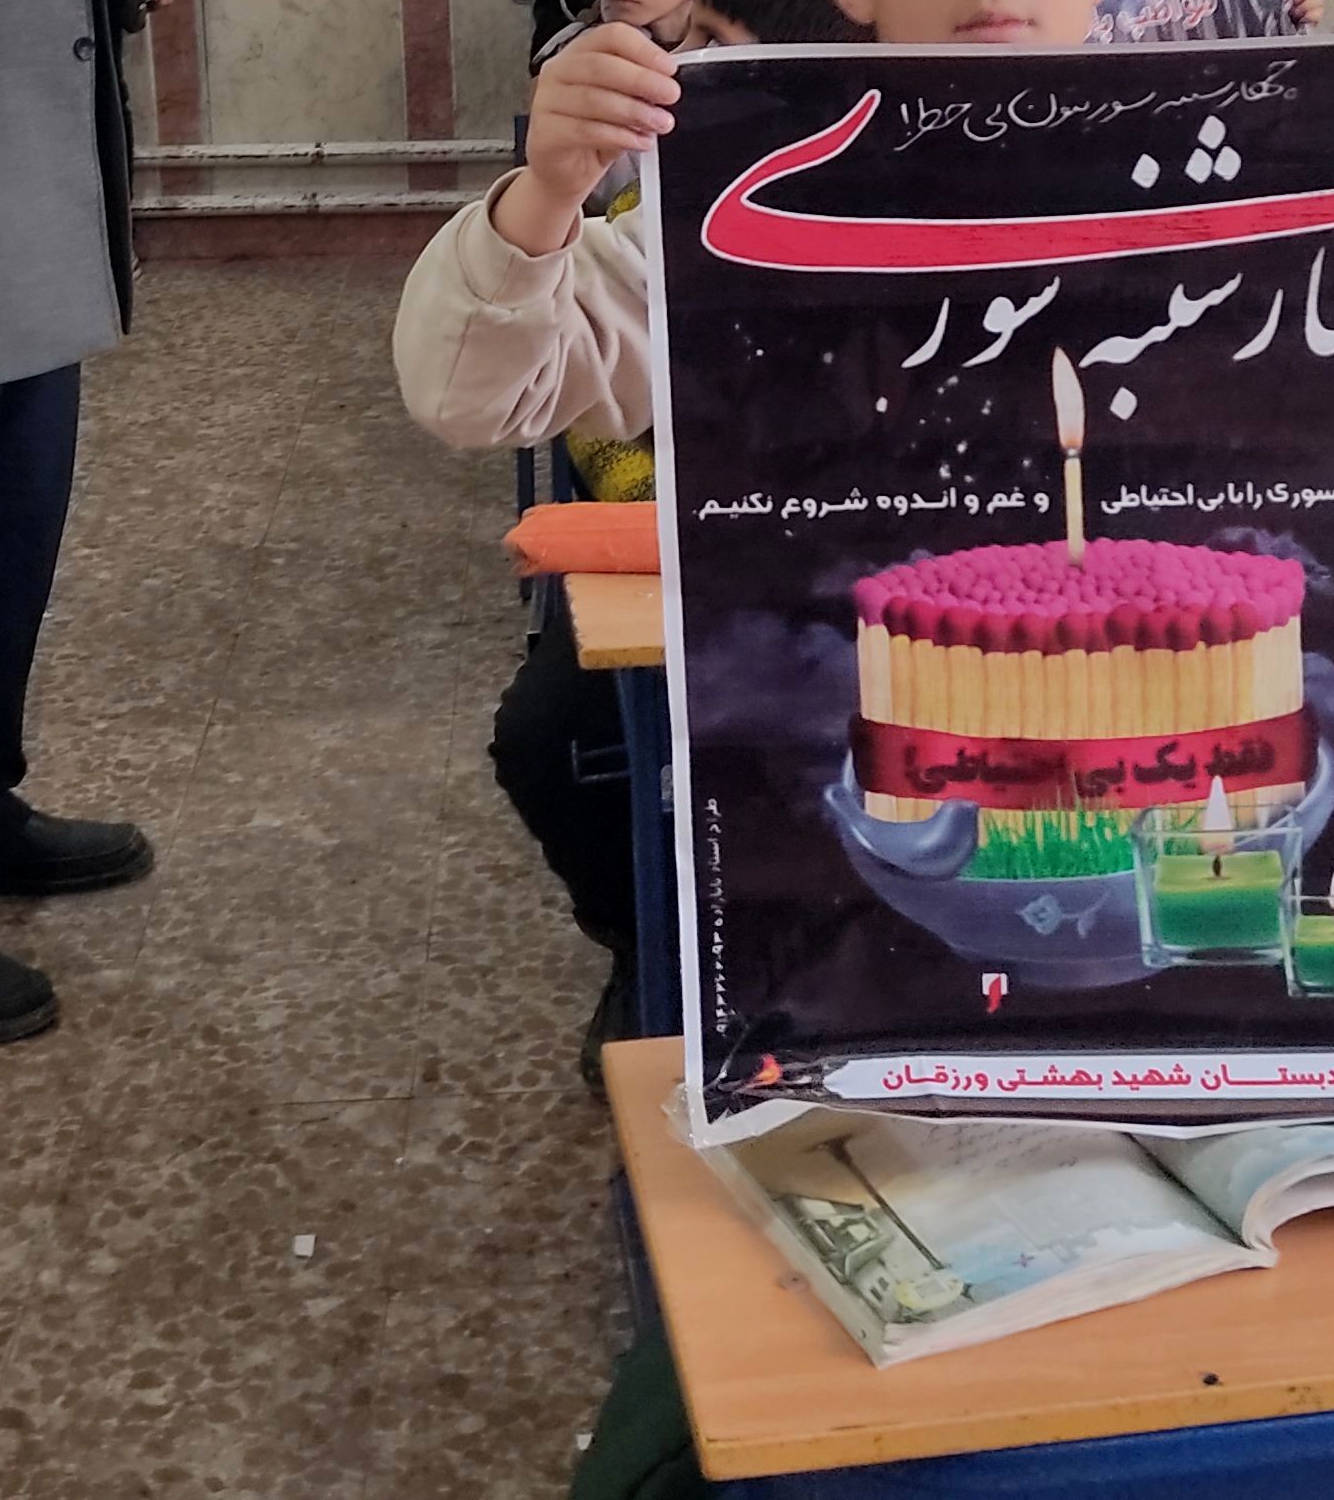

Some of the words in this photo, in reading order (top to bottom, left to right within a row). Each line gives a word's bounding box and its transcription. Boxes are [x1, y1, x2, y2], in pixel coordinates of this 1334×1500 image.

[780, 486, 869, 520] شروع
[875, 486, 956, 516] اندوه
[963, 492, 981, 515] و
[986, 486, 1027, 515] غم
[1033, 491, 1051, 514] و
[1101, 483, 1194, 514] احتیاطی
[1133, 741, 1198, 789] یک
[881, 1064, 990, 1092] ورزقان
[996, 1064, 1104, 1092] بهشتی
[1111, 1063, 1193, 1092] شهید
